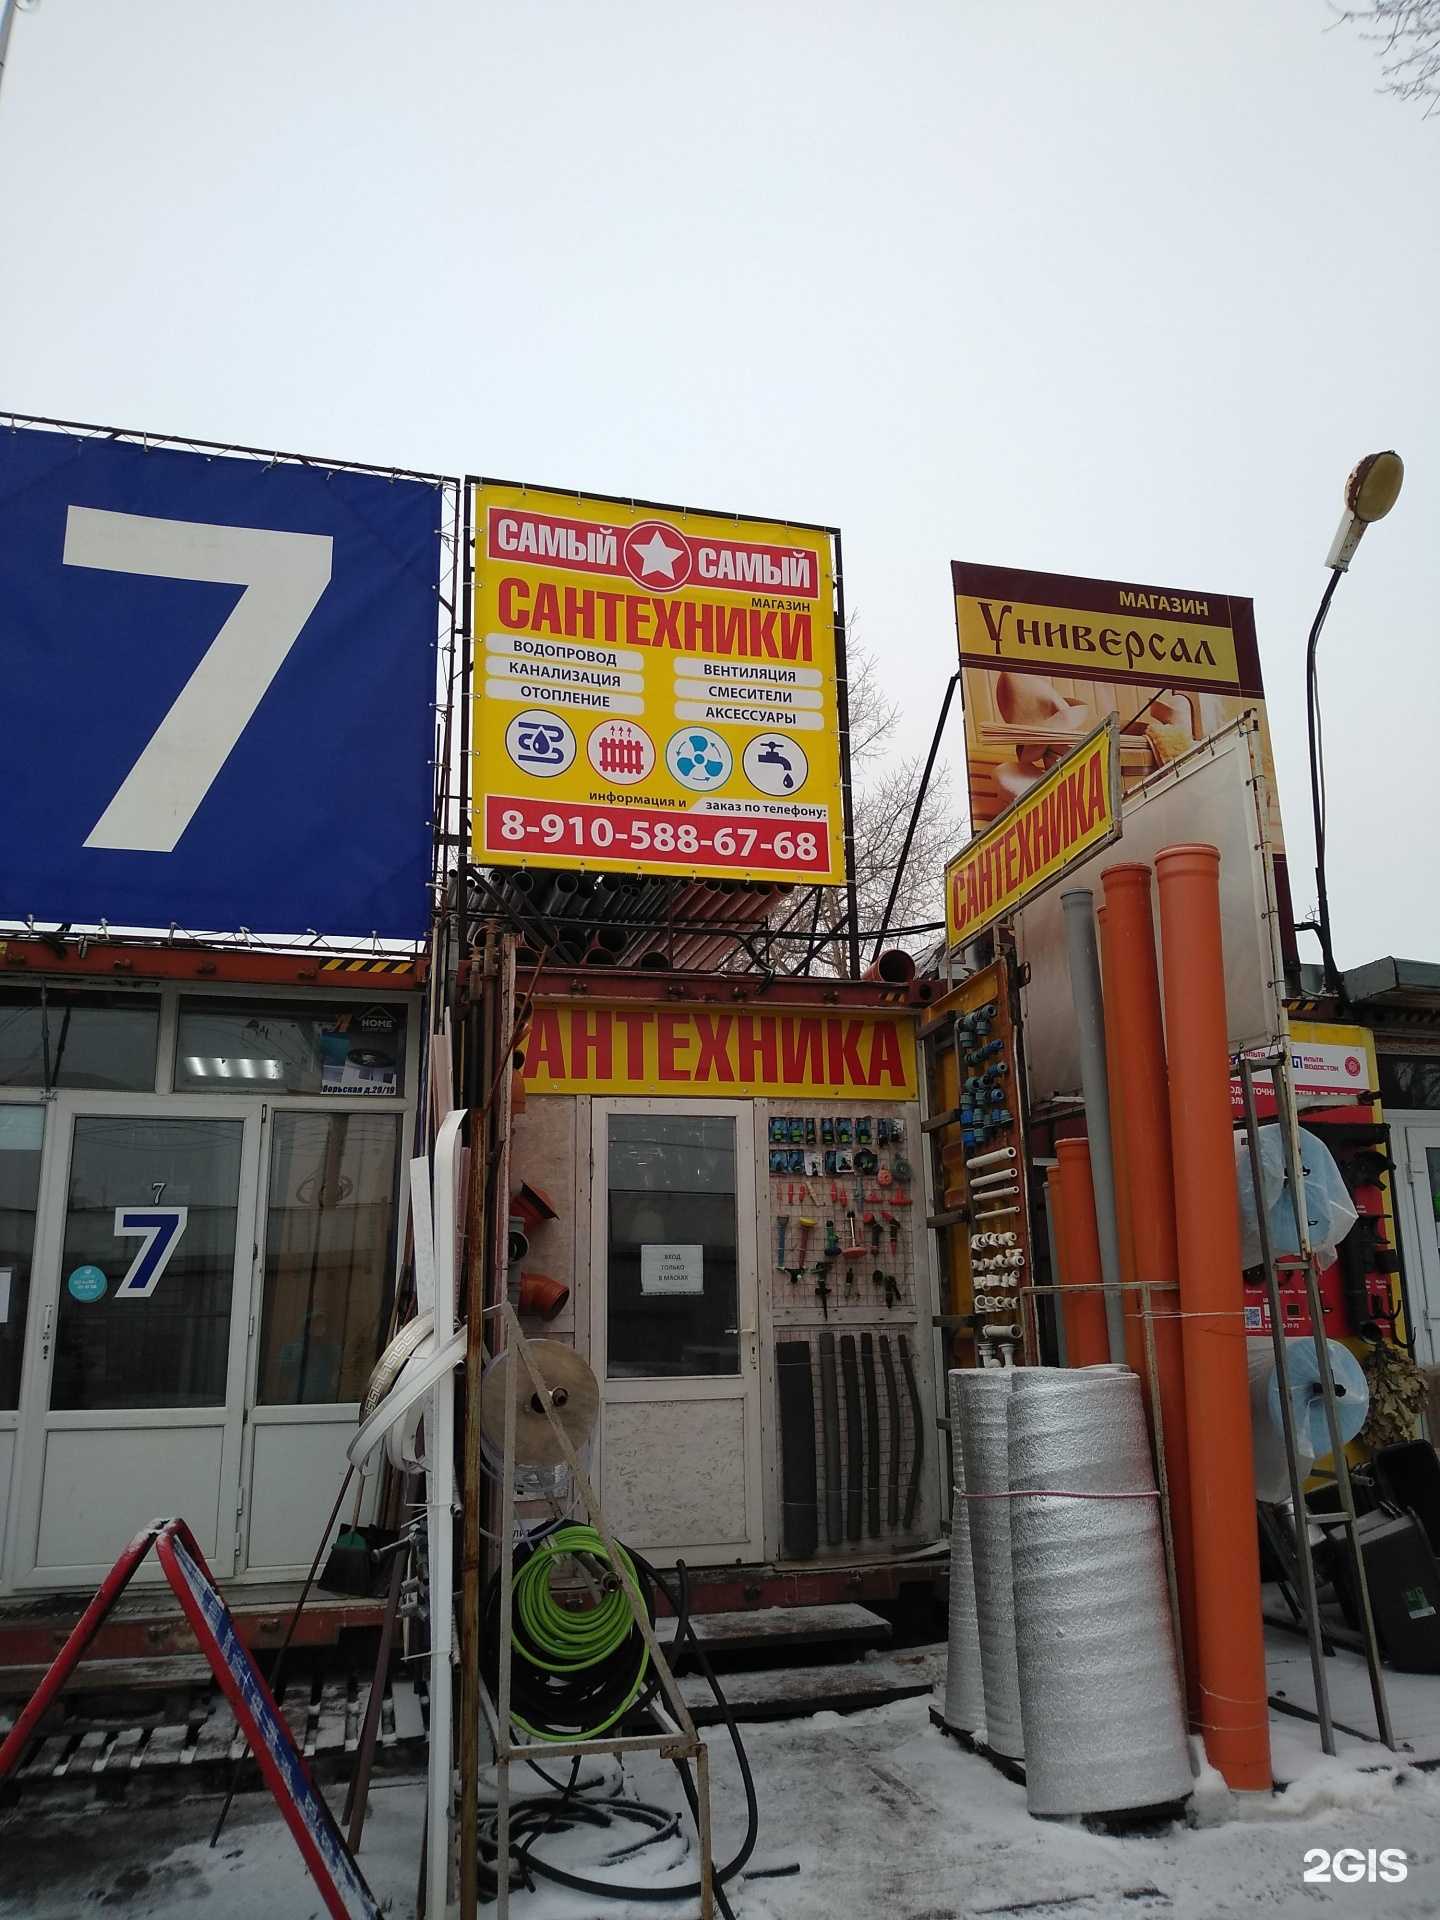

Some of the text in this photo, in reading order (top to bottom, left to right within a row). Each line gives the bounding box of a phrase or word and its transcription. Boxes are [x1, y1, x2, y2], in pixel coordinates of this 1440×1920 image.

[498, 518, 810, 588] САМЫЙ САМЫЙ
[751, 597, 811, 613] МАГАЗИН
[1119, 591, 1209, 616] МАГАЗИН
[498, 577, 813, 662] САНТЕХНИКИ
[977, 601, 1217, 668] Универсал
[513, 640, 617, 667] ВОДОПРОВОД
[63, 505, 333, 852] 7
[509, 662, 621, 688] КАНАЛИЗАЦИЯ
[704, 663, 796, 683] ВЕНТИЛЯЦИЯ
[521, 685, 611, 708] ОТОПЛЕНИЕ
[708, 685, 793, 704] СМЕСИТЕЛИ
[705, 707, 797, 725] АКСЕССУАРЫ
[589, 790, 827, 819] информация и заказ по телефону:
[501, 810, 818, 861] 8-910-588-67-68
[952, 750, 1107, 931] САНТЕХНИКА
[361, 1019, 393, 1028] HOME
[522, 1009, 906, 1087] АНТЕХНИКА
[152, 1182, 168, 1205] 7
[114, 1207, 188, 1298] 7
